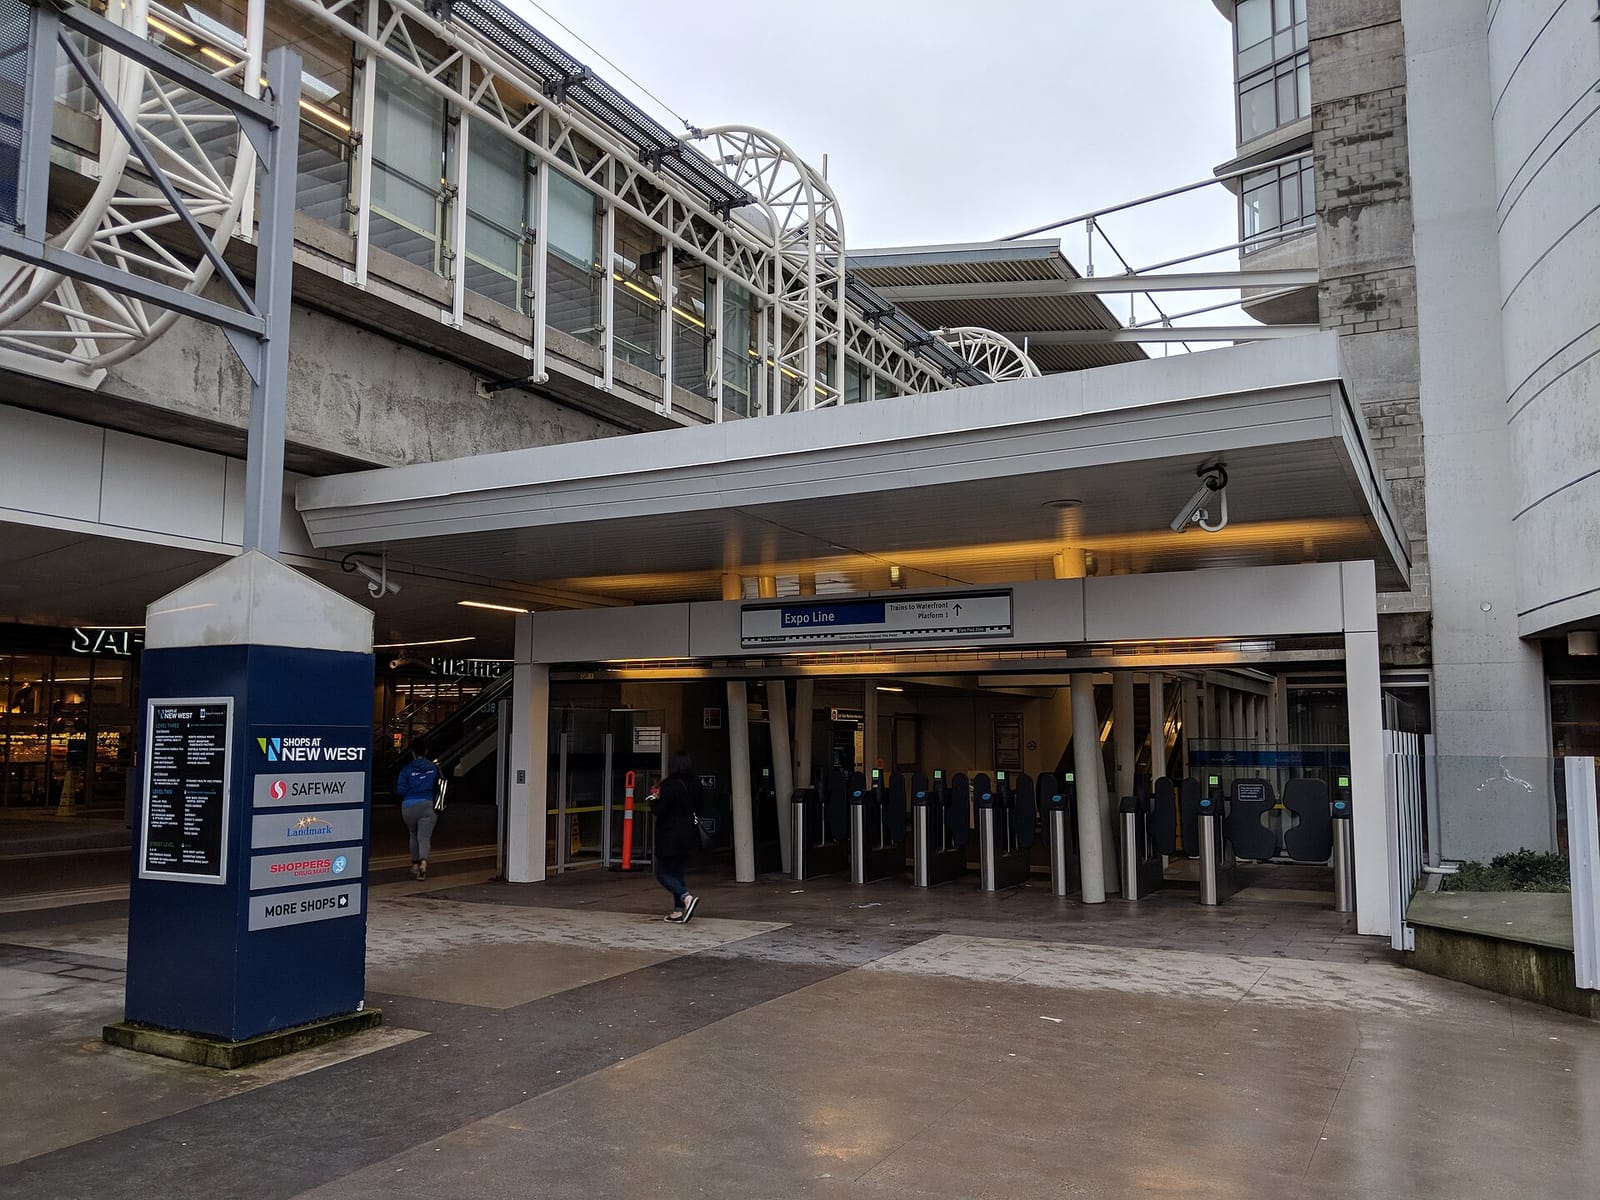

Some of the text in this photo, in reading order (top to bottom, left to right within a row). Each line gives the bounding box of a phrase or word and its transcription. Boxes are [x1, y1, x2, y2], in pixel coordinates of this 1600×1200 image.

[916, 602, 949, 610] Waterfront
[785, 611, 835, 626] Expo Line
[283, 737, 322, 747] SHOPS AT
[282, 747, 366, 761] NEW WEST
[291, 781, 346, 796] SAFEWAY
[287, 825, 332, 837] Landmark
[269, 859, 331, 873] SHOPPERS
[264, 897, 336, 918] MORE SHOPS
